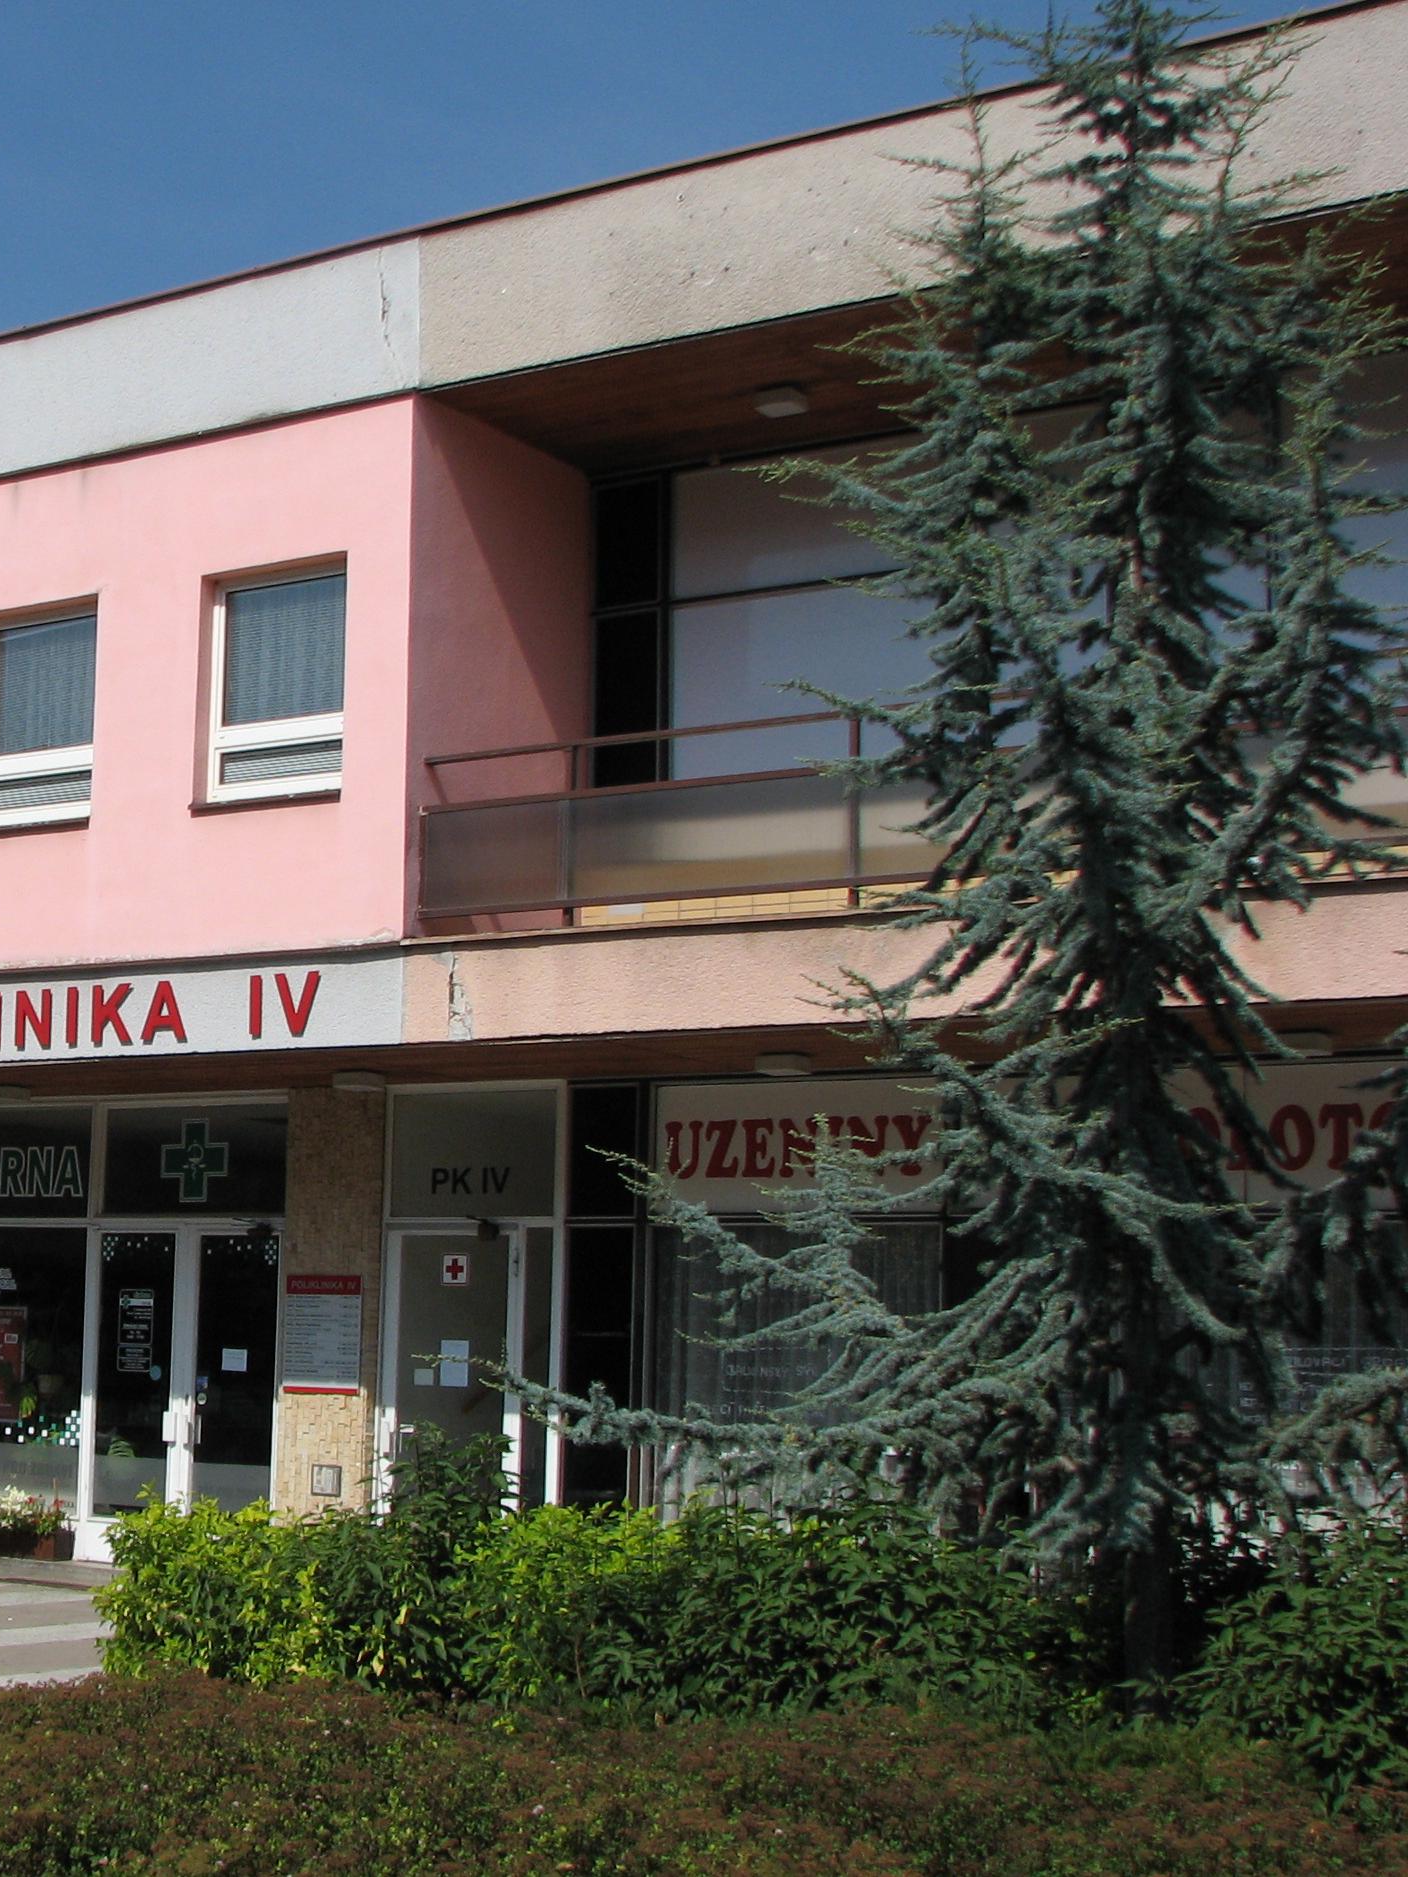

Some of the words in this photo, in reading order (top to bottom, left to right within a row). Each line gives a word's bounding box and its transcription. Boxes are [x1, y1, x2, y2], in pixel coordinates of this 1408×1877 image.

[248, 971, 321, 1040] IV
[431, 1167, 472, 1194] PK
[482, 1166, 510, 1193] IV
[291, 1279, 343, 1290] POLIKLINIKA
